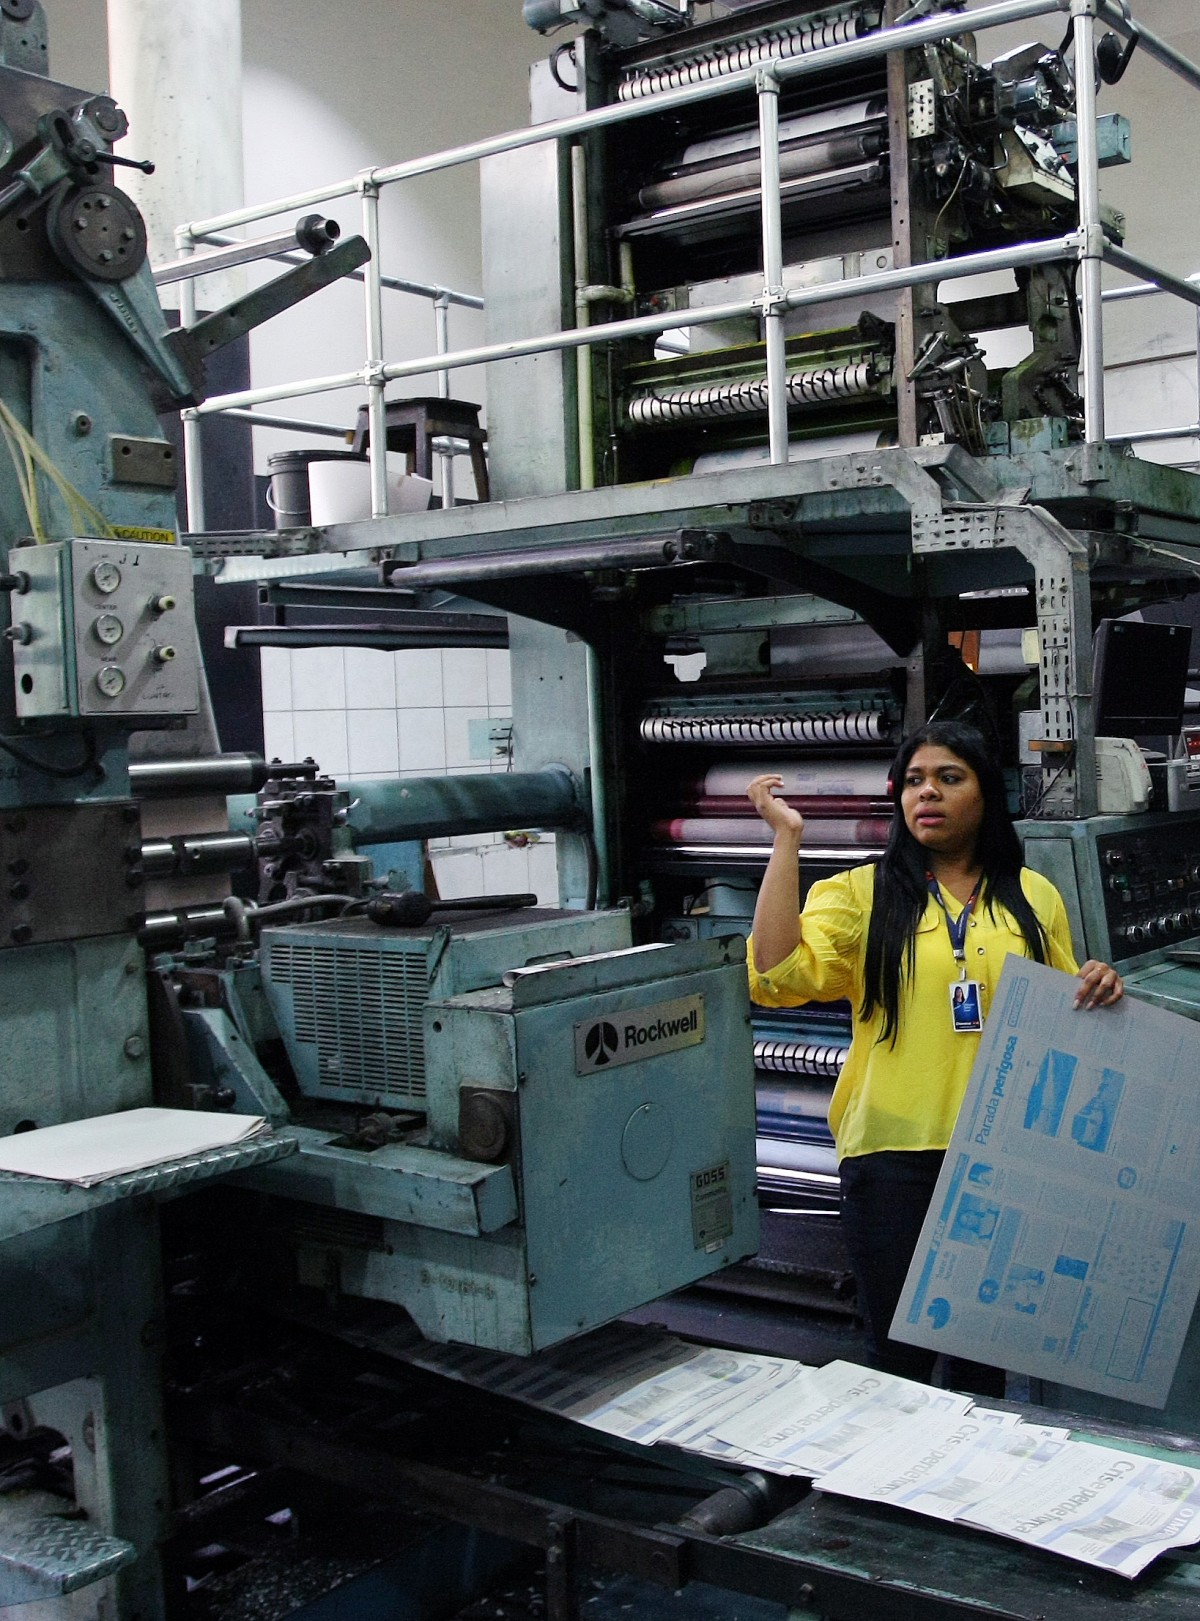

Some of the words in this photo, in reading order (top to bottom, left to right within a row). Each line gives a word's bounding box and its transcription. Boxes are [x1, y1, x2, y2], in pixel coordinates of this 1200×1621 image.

[121, 530, 169, 543] CAUTION
[624, 1009, 698, 1048] Rockwell
[975, 1097, 1000, 1146] Parada
[992, 1035, 1018, 1098] perigosa
[695, 1167, 725, 1188] GOSS
[938, 1424, 980, 1452] Crise
[903, 1448, 947, 1478] perde
[1089, 1460, 1136, 1489] Crise
[1050, 1486, 1098, 1517] perde
